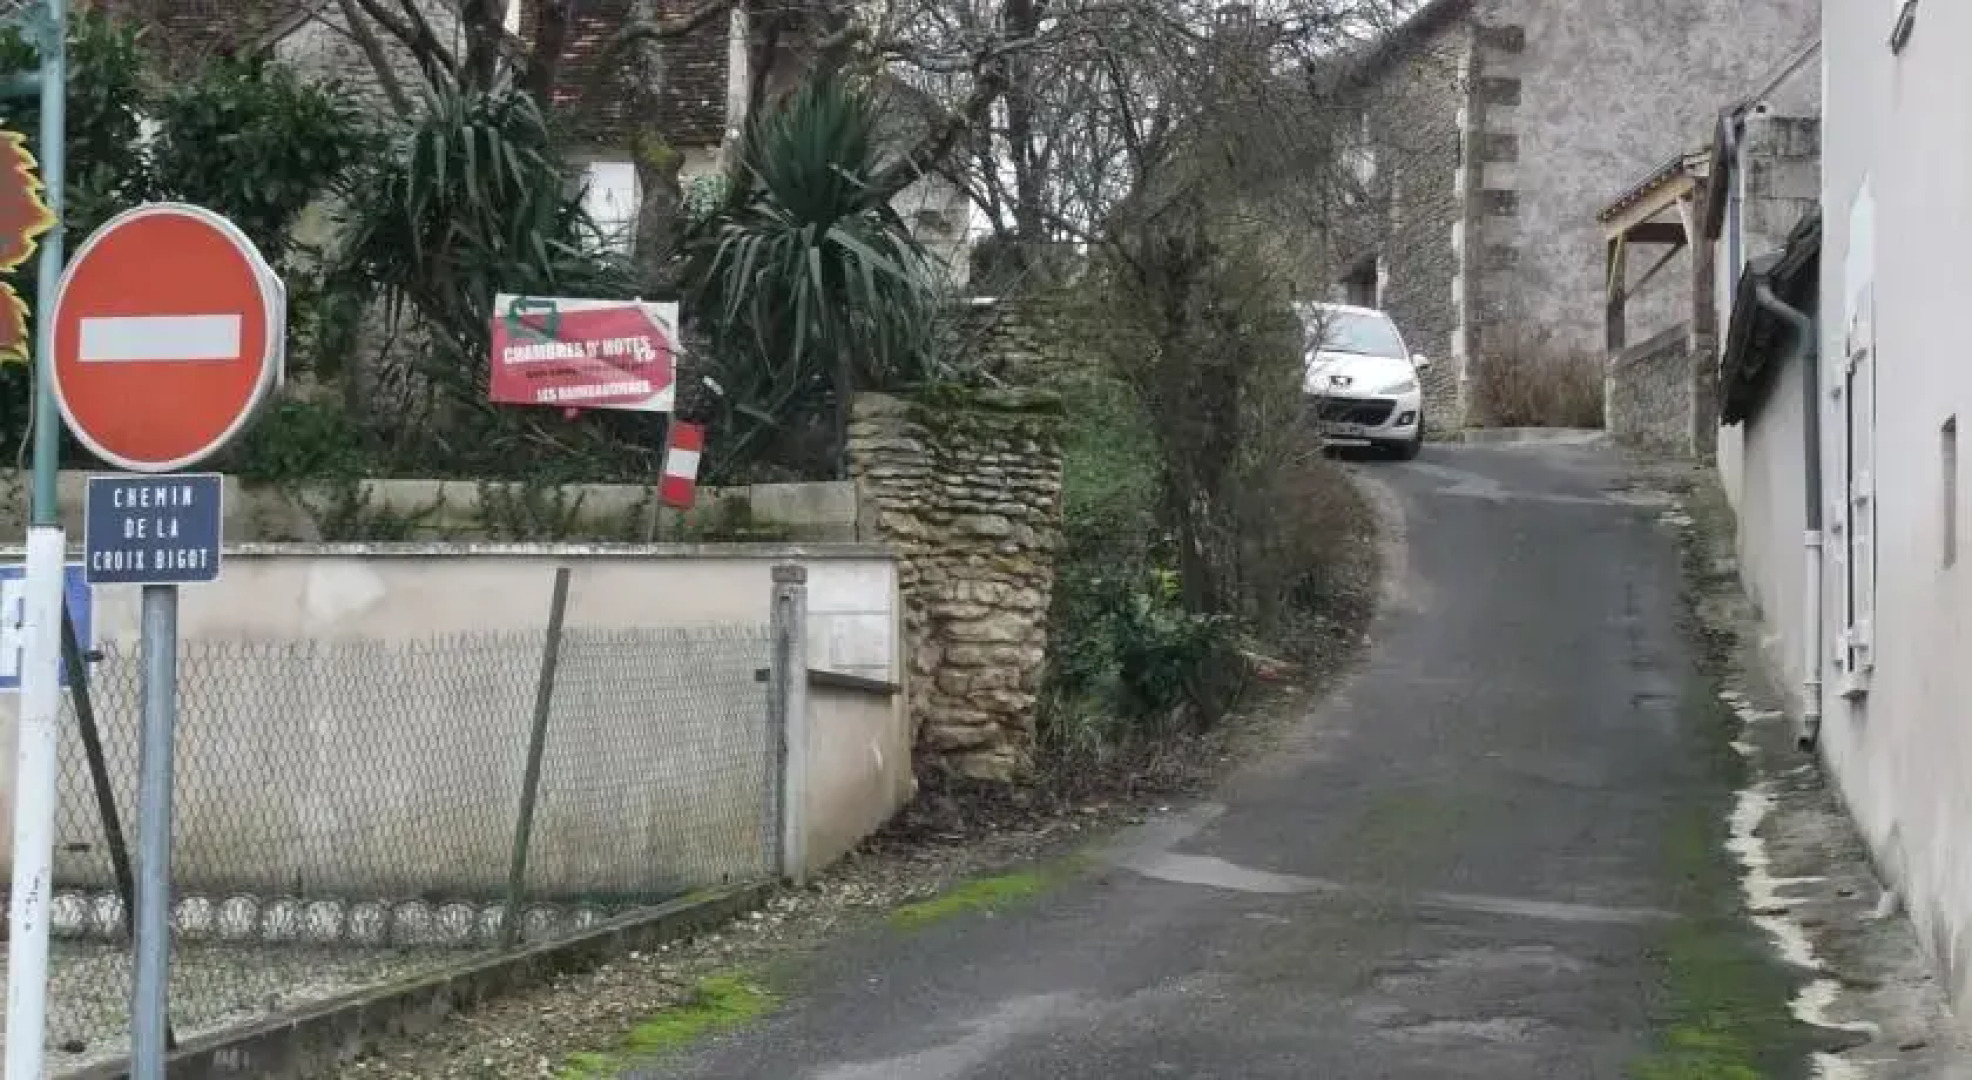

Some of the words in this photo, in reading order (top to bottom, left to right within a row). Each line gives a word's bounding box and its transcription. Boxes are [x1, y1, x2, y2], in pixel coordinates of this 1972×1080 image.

[504, 342, 584, 363] CHAMBRES
[114, 486, 192, 507] CHEMIN
[124, 518, 147, 539] DE
[156, 519, 179, 538] LA
[93, 551, 144, 571] CROIX
[155, 548, 207, 569] BIGOT
